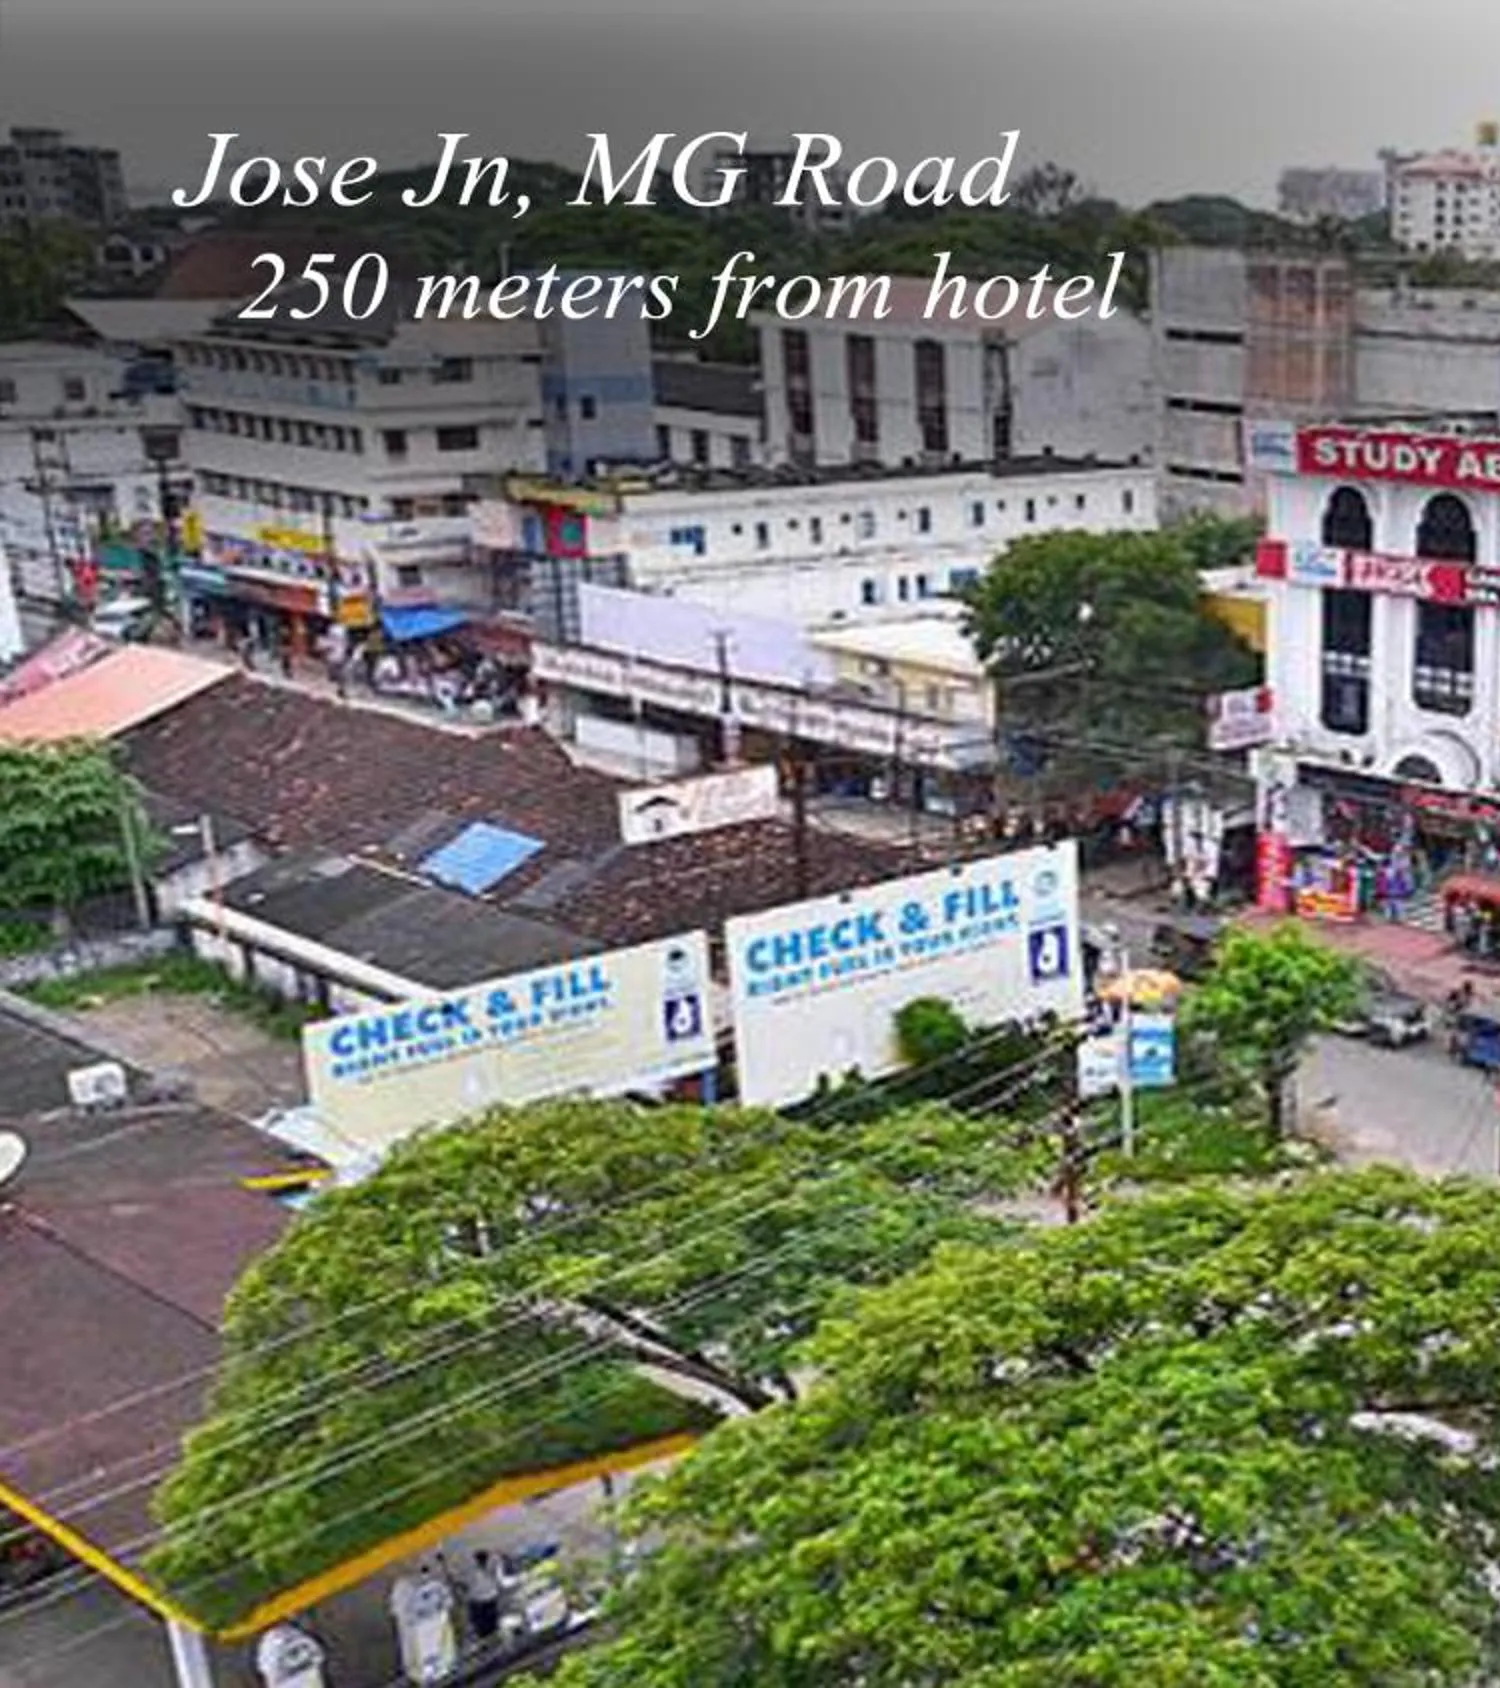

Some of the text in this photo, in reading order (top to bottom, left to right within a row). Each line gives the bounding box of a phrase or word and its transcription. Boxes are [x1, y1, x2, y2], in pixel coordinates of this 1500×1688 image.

[1314, 437, 1442, 476] STUDY
[745, 880, 1020, 973] CHECK & FILL
[329, 963, 612, 1057] CHECK & FILL
